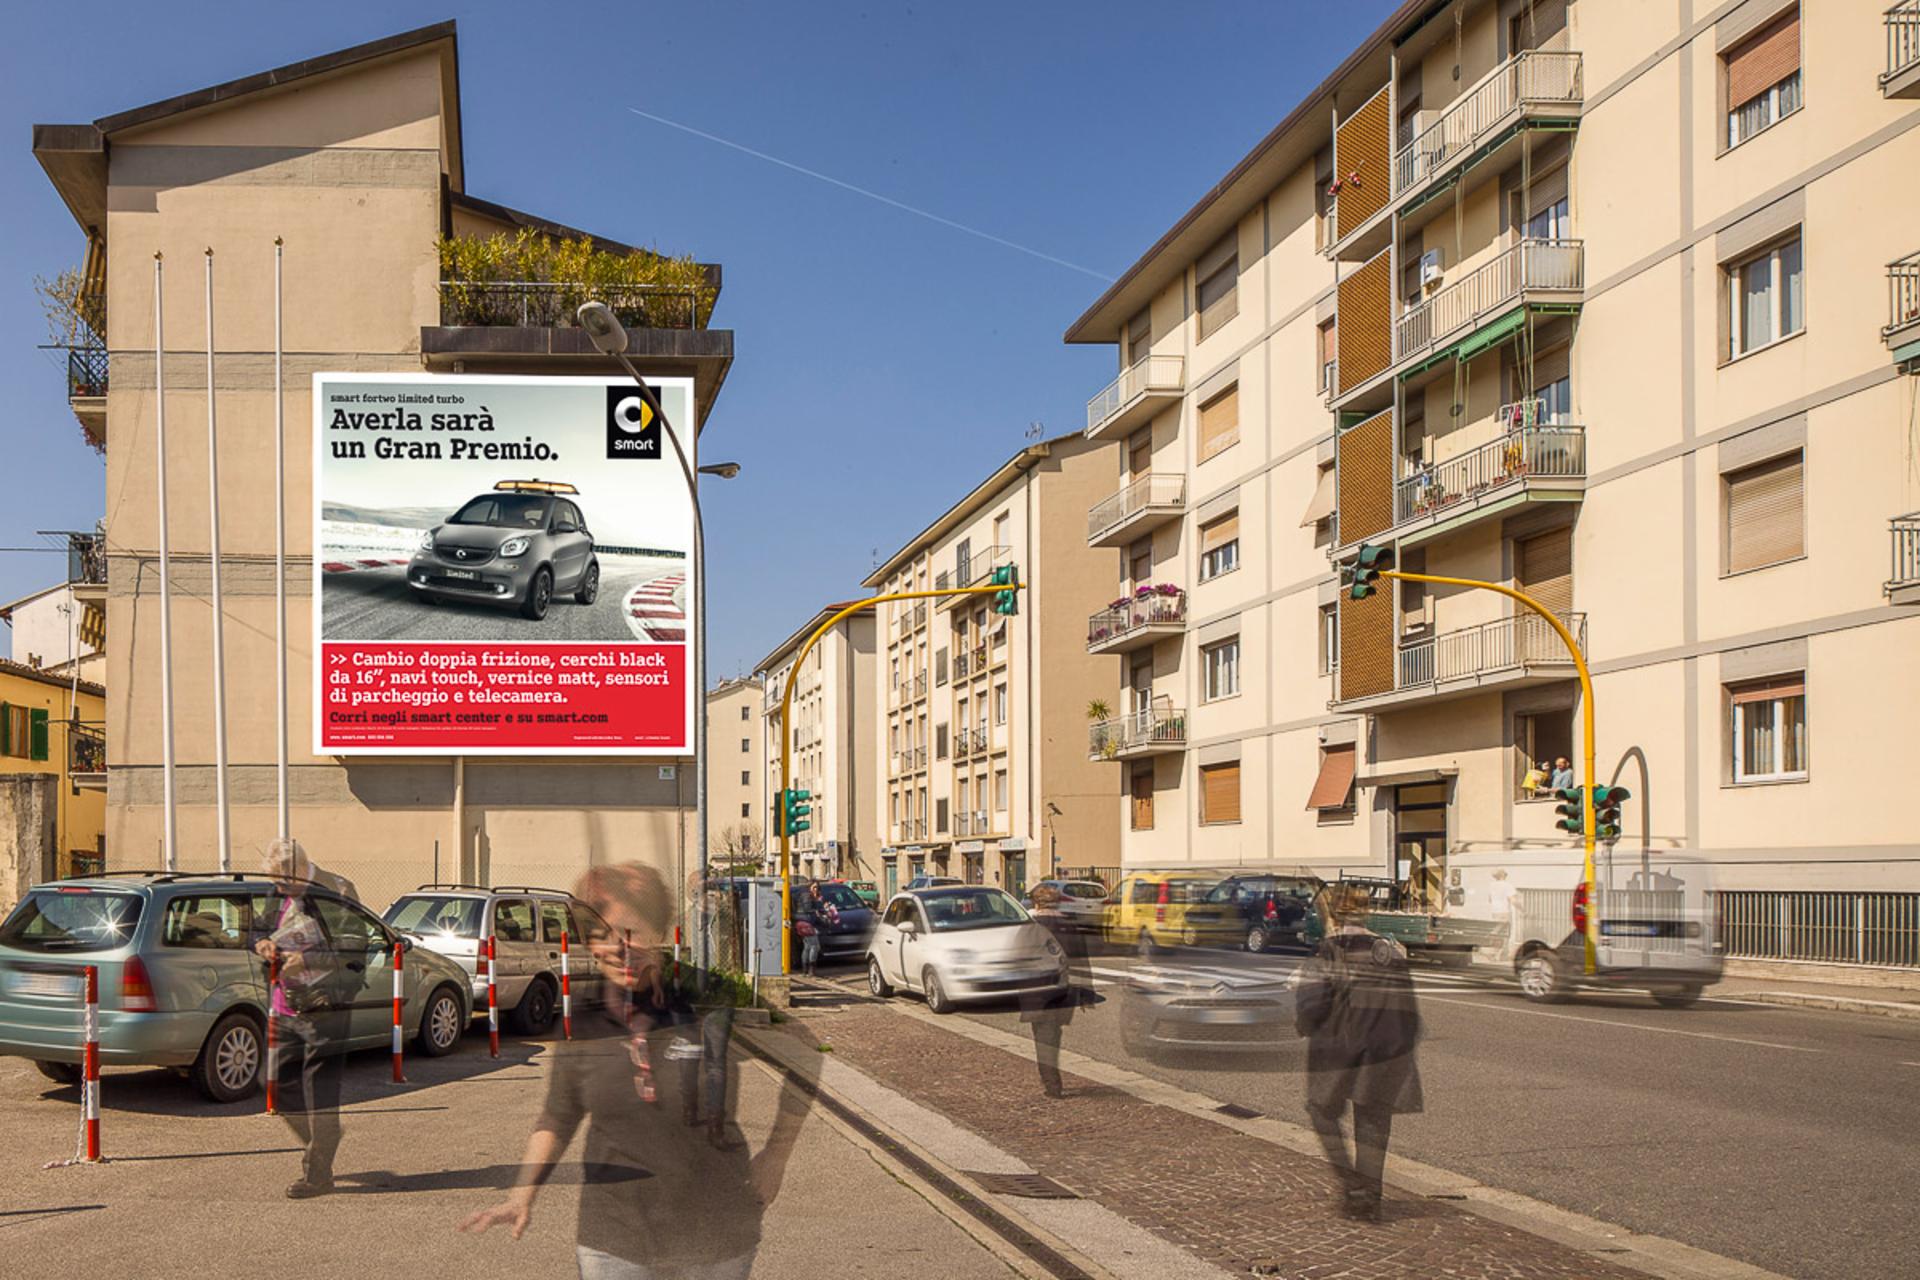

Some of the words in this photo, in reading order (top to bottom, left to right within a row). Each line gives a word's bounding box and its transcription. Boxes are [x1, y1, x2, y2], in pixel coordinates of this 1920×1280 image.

[330, 394, 361, 403] smart
[362, 393, 396, 404] fortwo
[397, 394, 434, 404] limited
[436, 394, 465, 404] turbo
[330, 407, 423, 431] Averla
[430, 405, 495, 432] sarà
[330, 441, 366, 459] un
[374, 437, 442, 460] Gran
[450, 436, 559, 461] Premio.
[614, 438, 654, 451] smart
[352, 652, 415, 667] Cambio
[419, 652, 477, 670] doppia
[481, 652, 556, 669] frizione,
[559, 651, 615, 667] cerchi
[619, 652, 666, 668] black
[329, 670, 351, 685] da
[390, 669, 427, 685] navi
[431, 669, 484, 688] touch,
[488, 670, 553, 685] vernice
[557, 671, 601, 688] matt,
[605, 670, 670, 686] sensori
[329, 688, 348, 703] di
[351, 688, 449, 706] parcheggio
[453, 691, 464, 703] e
[468, 688, 568, 704] telecamera.
[329, 710, 369, 724] Corri
[371, 710, 408, 726] negli
[410, 711, 452, 724] smart
[455, 711, 502, 724] center
[504, 713, 514, 724] e
[516, 713, 534, 724] su
[536, 711, 609, 724] smart.com
